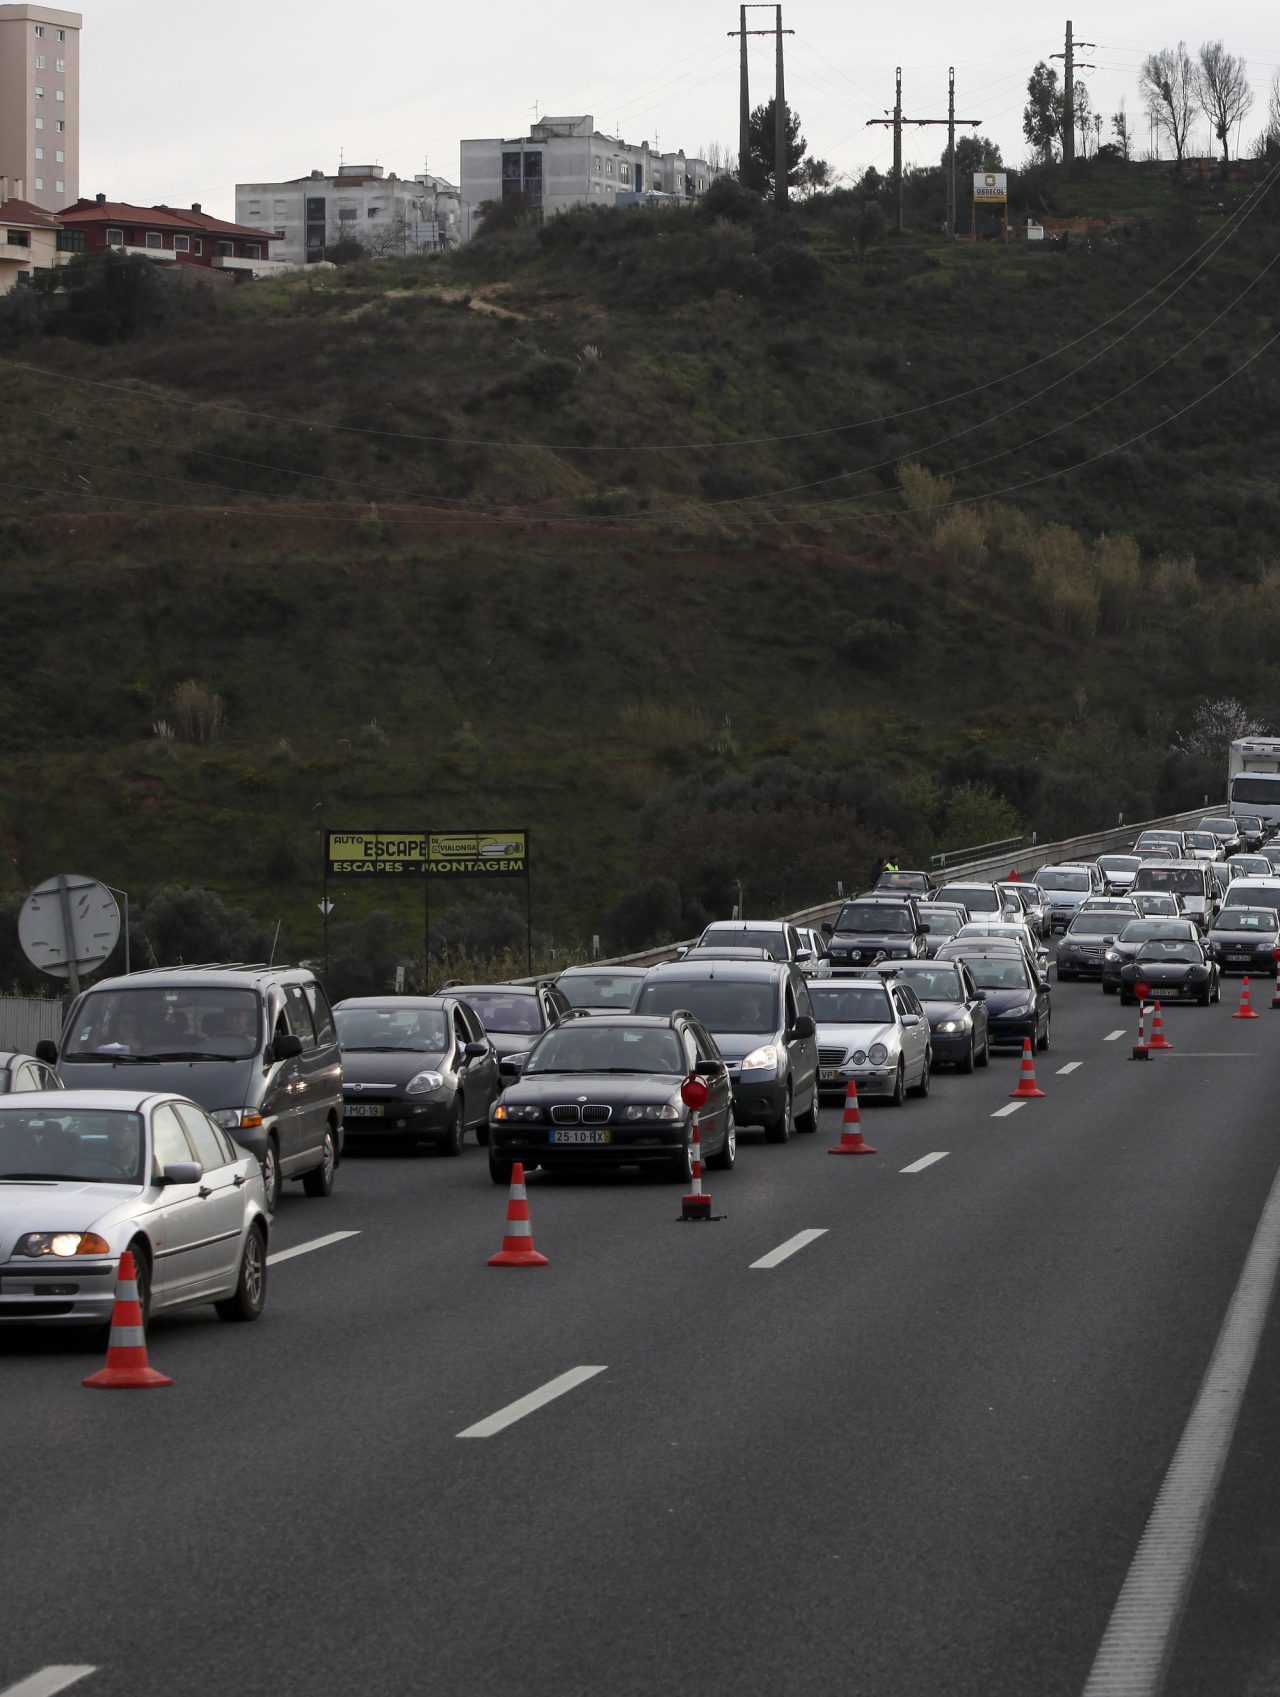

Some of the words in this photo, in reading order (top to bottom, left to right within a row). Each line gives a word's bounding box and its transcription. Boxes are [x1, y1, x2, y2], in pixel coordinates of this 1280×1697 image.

[334, 836, 364, 844] AUTO
[364, 841, 427, 857] ESCAPE
[333, 862, 403, 872] ESCAPES
[421, 861, 524, 872] MONTAGEM
